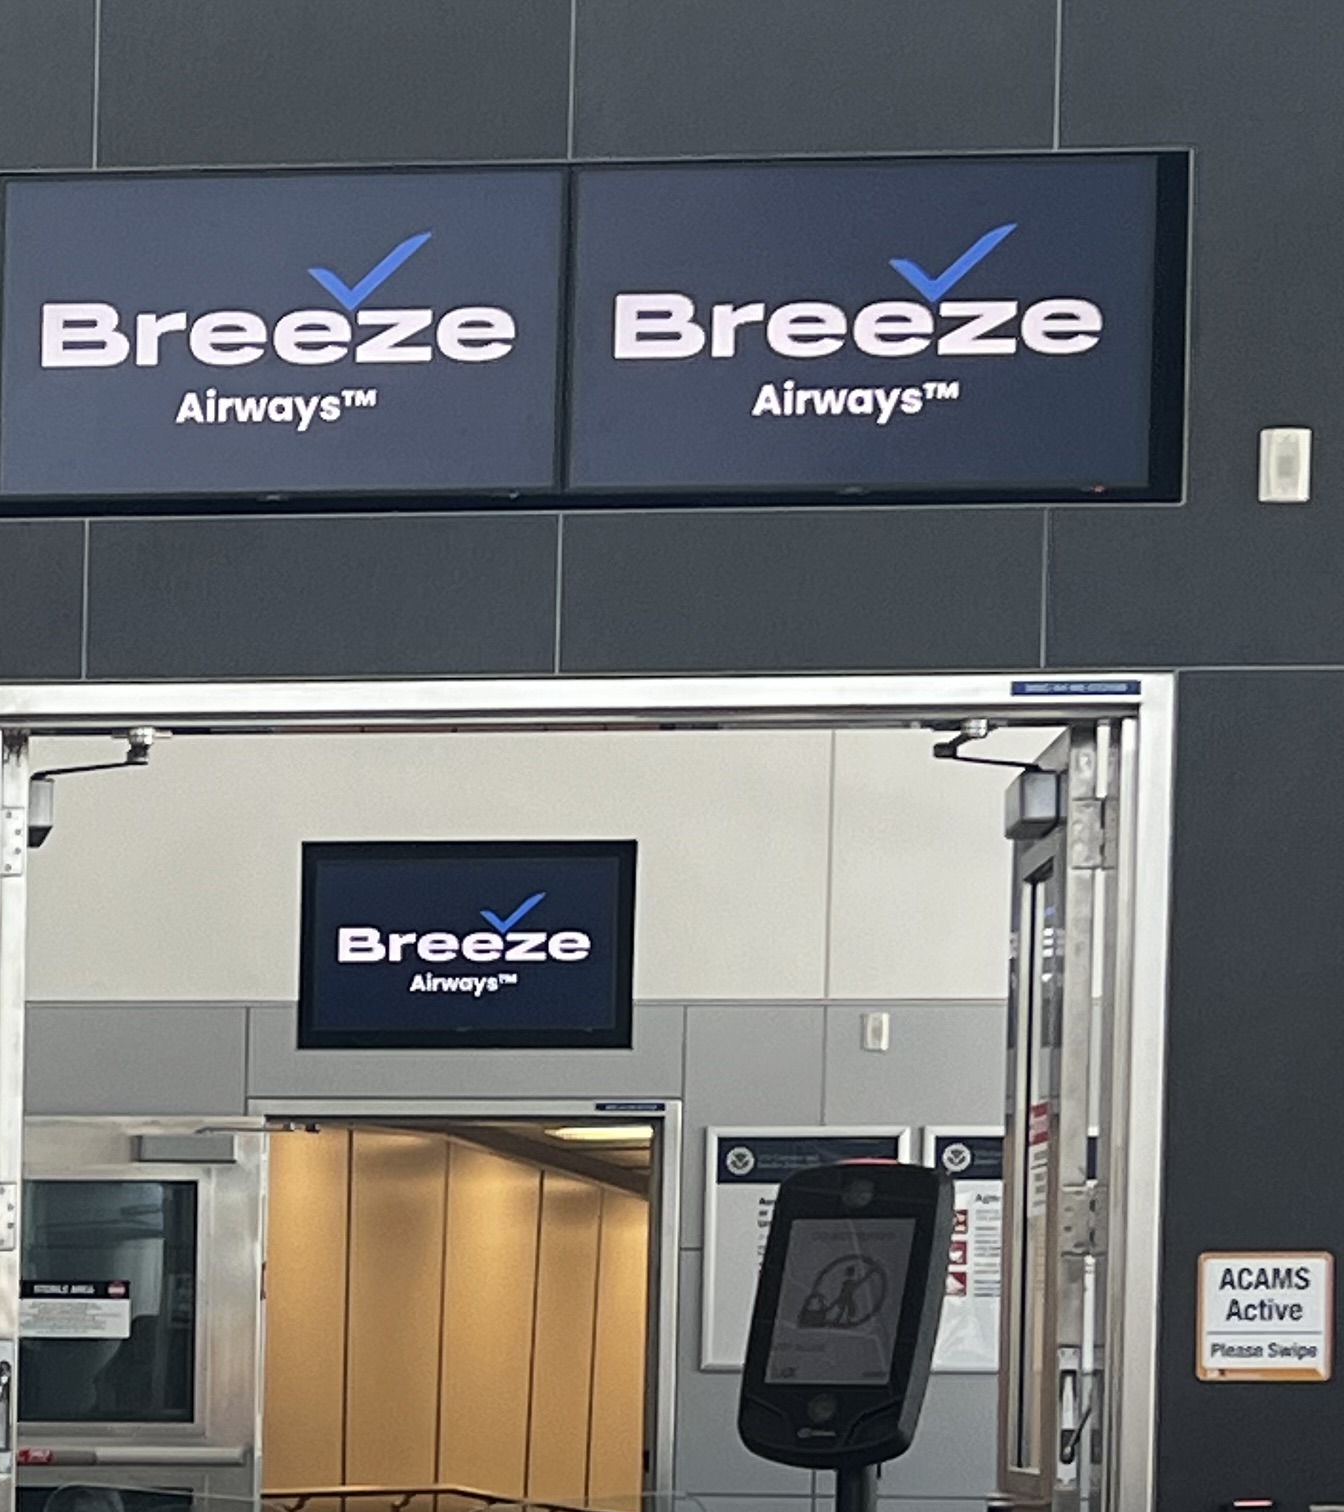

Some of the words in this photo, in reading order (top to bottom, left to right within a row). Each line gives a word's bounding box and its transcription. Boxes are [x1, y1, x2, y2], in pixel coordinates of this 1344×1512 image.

[40, 300, 517, 369] Breeze
[612, 292, 1103, 361] Breeze
[337, 927, 592, 963] Breeze
[1219, 1267, 1311, 1290] ACAMS
[1225, 1298, 1303, 1321] Active
[1210, 1342, 1263, 1358] Please
[1267, 1342, 1318, 1360] Swipe
